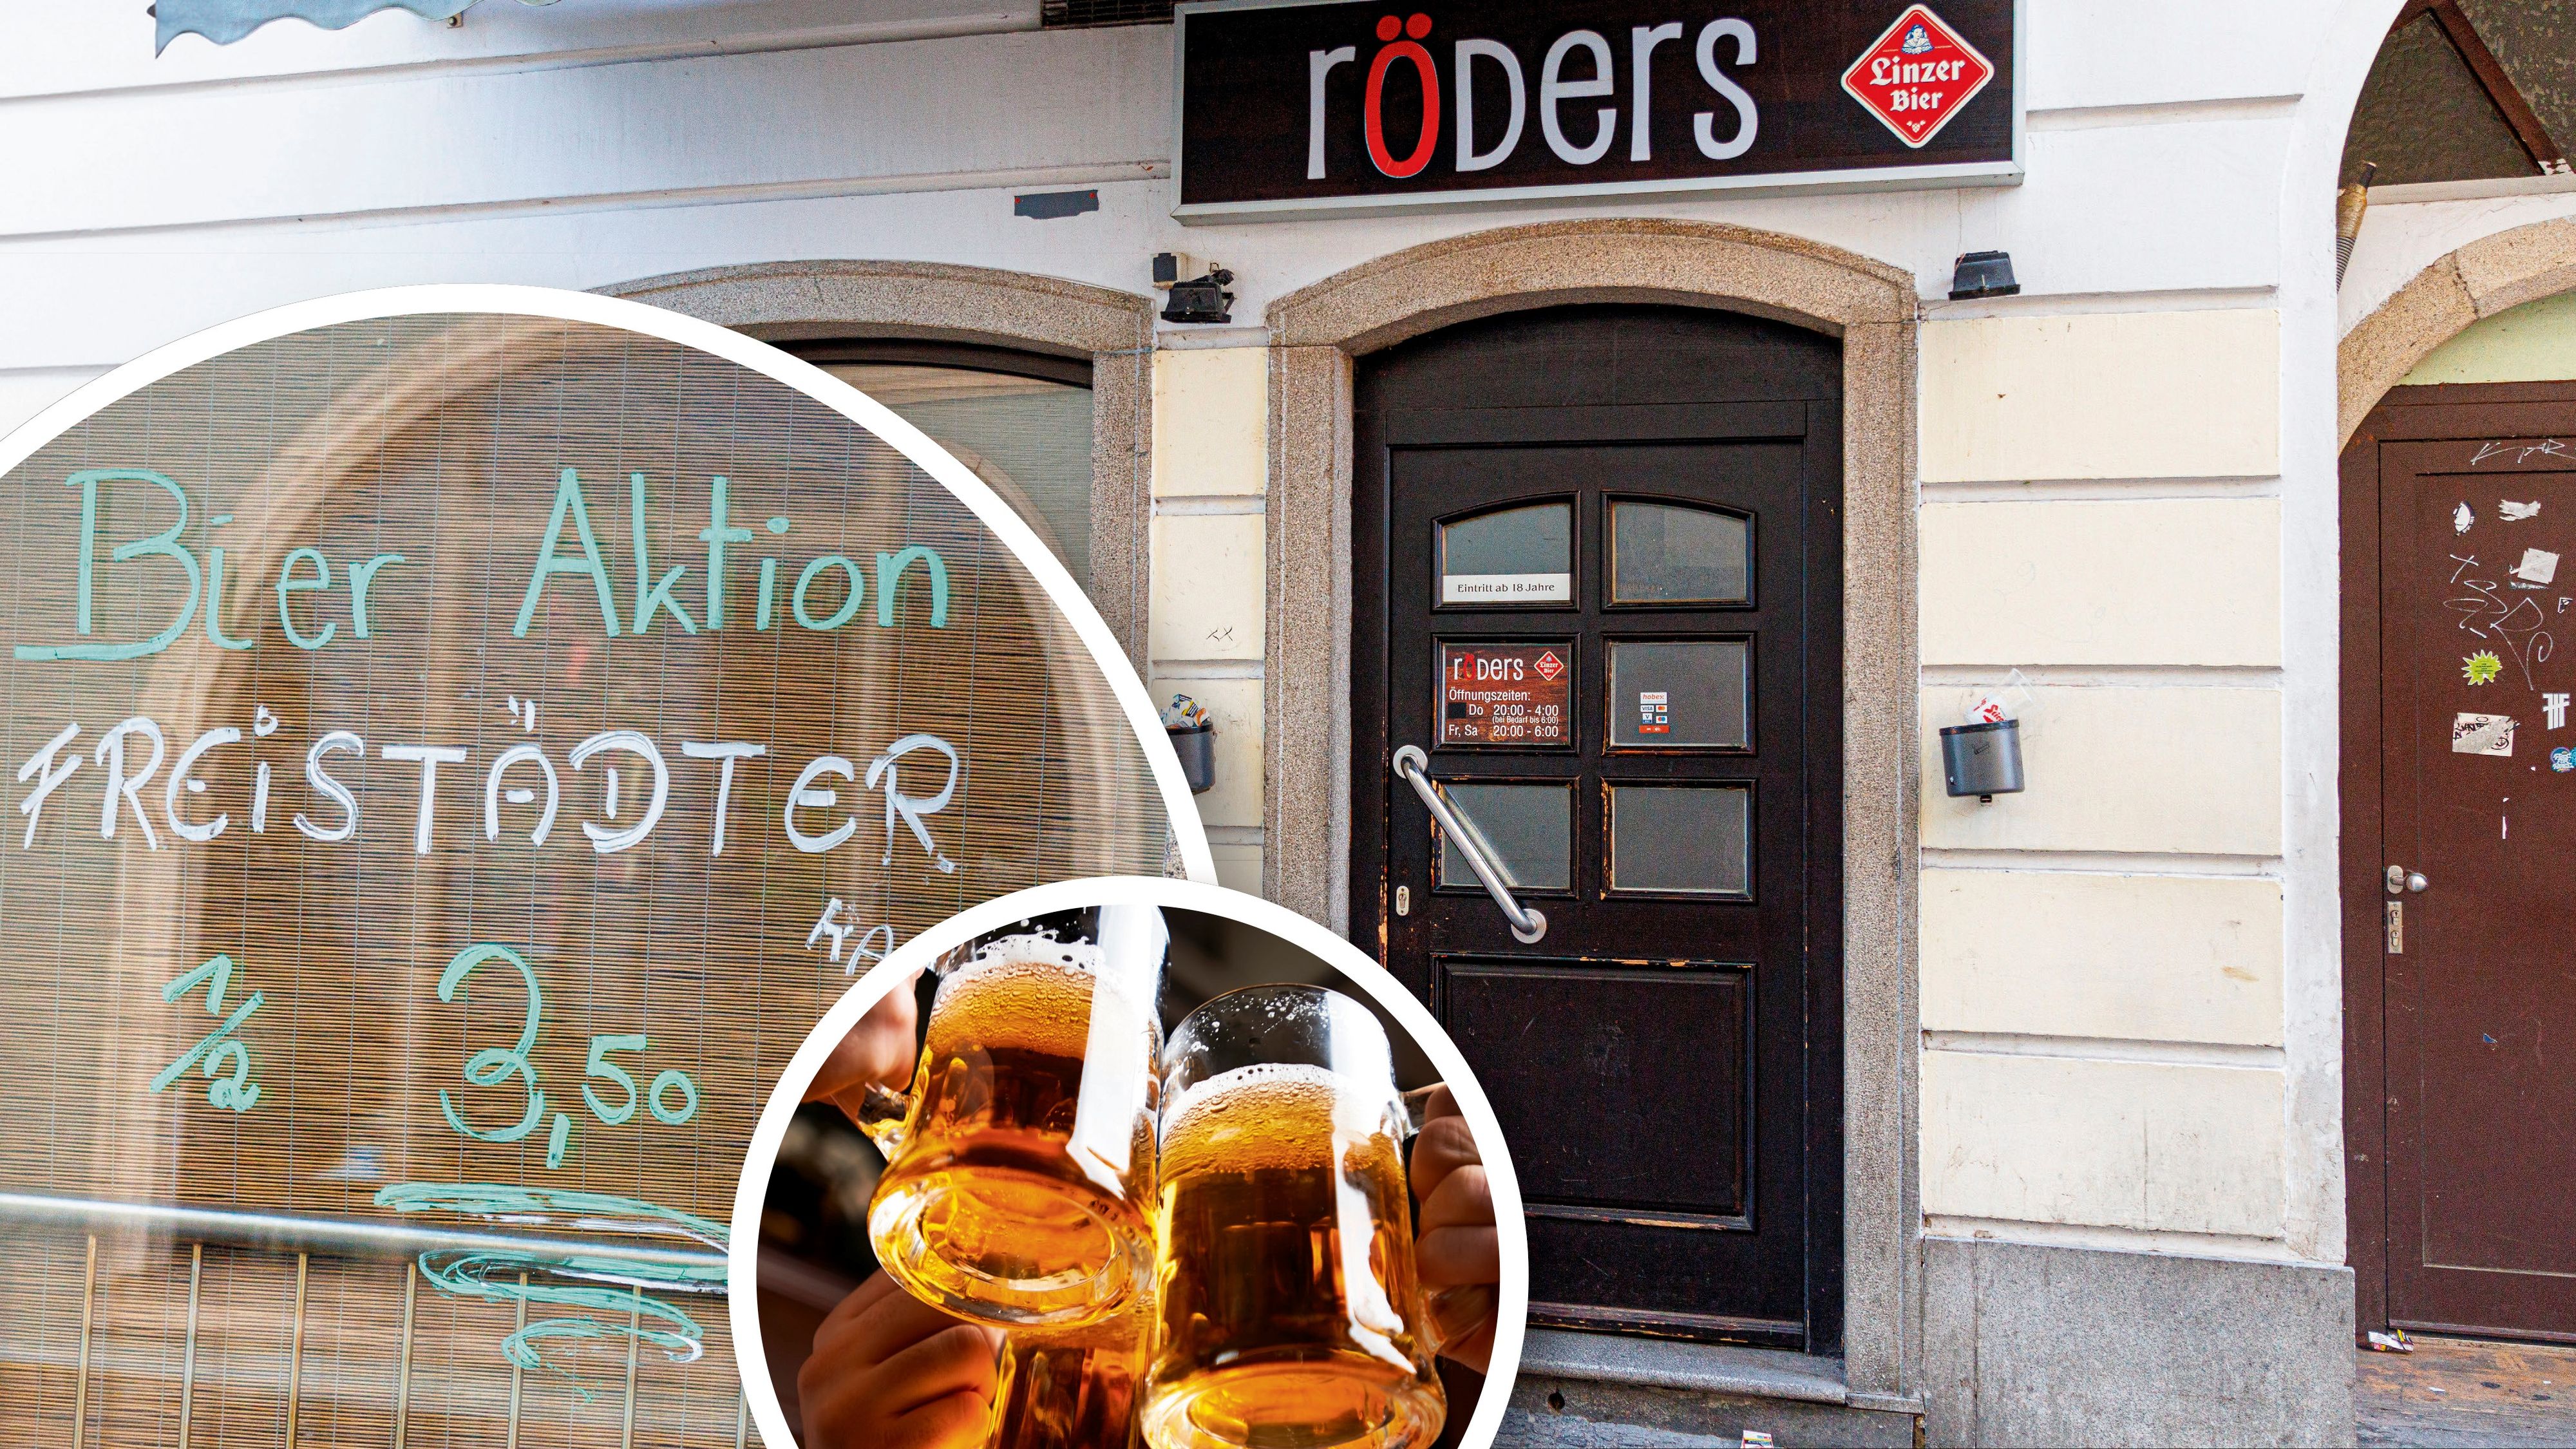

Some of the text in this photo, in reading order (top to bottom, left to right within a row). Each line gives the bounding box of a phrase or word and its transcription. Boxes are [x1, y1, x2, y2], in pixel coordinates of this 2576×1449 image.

[1869, 55, 1965, 86] Linzer
[1889, 86, 1944, 112] Bier
[13, 468, 949, 661] Bier Aktion
[1457, 583, 1555, 592] Eintritt ab 18 Jahre
[1449, 687, 1531, 703] Öffnungszeiten:
[1469, 704, 1484, 715] Do
[1493, 705, 1524, 716] 20:00
[1535, 705, 1559, 716] 4:00
[1492, 716, 1504, 724] (bei
[1506, 715, 1528, 724] Bedarf
[1540, 716, 1559, 724] 6:00)
[1448, 724, 1461, 737] Fr,
[1464, 724, 1478, 736] Sa
[1493, 725, 1524, 737] 20:00
[1534, 725, 1559, 737] 6:00
[149, 943, 699, 1170] 1/2 3,50
